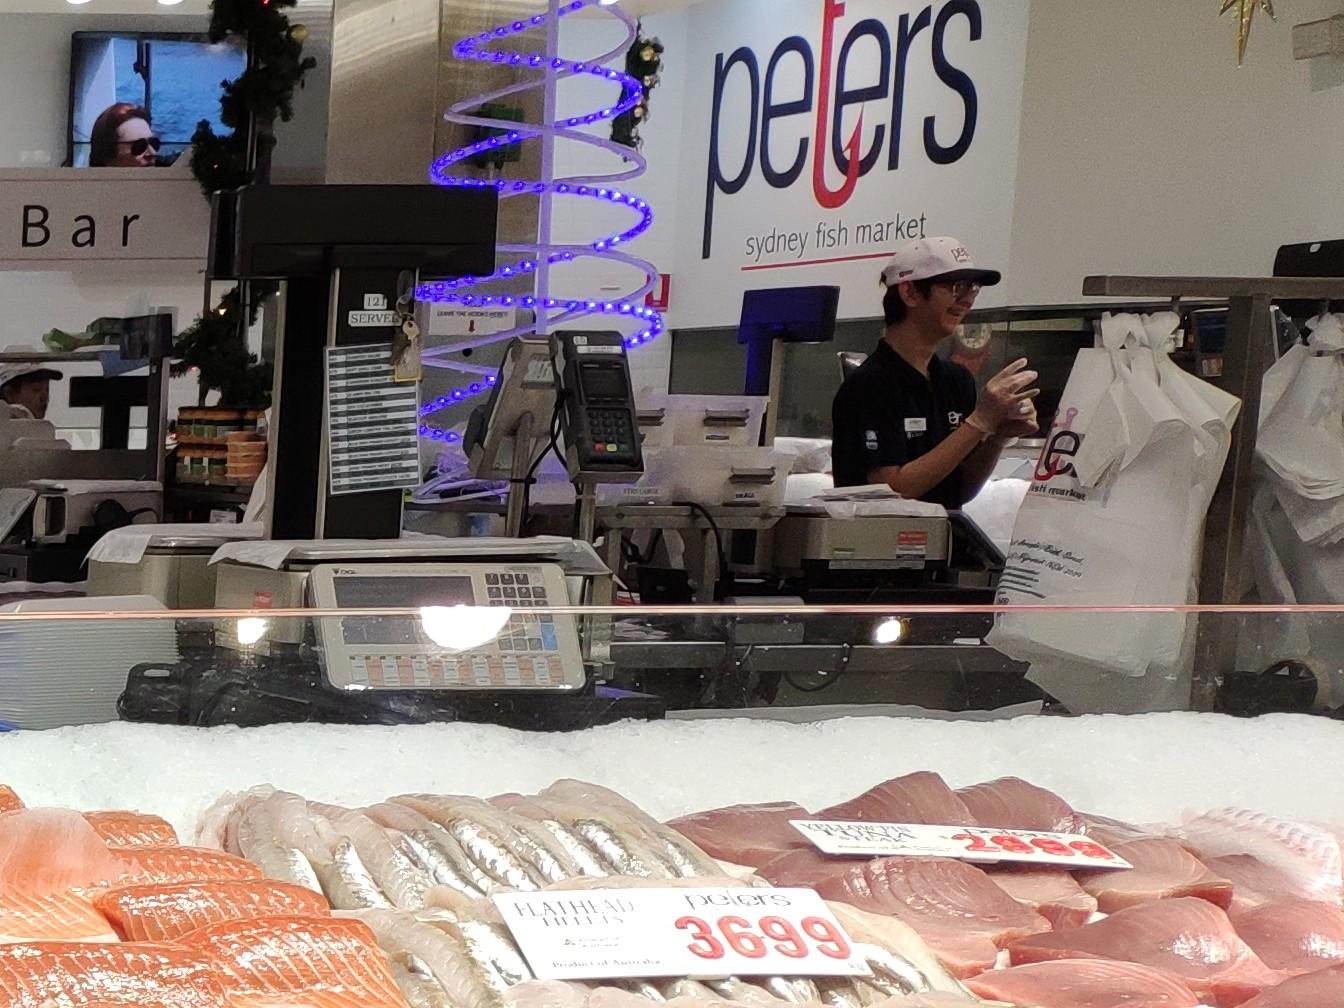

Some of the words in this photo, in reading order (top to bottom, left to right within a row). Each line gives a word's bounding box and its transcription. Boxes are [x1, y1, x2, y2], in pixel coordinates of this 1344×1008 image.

[20, 205, 140, 248] Bar
[745, 228, 809, 263] sydney
[816, 221, 849, 249] fish
[856, 212, 927, 243] market
